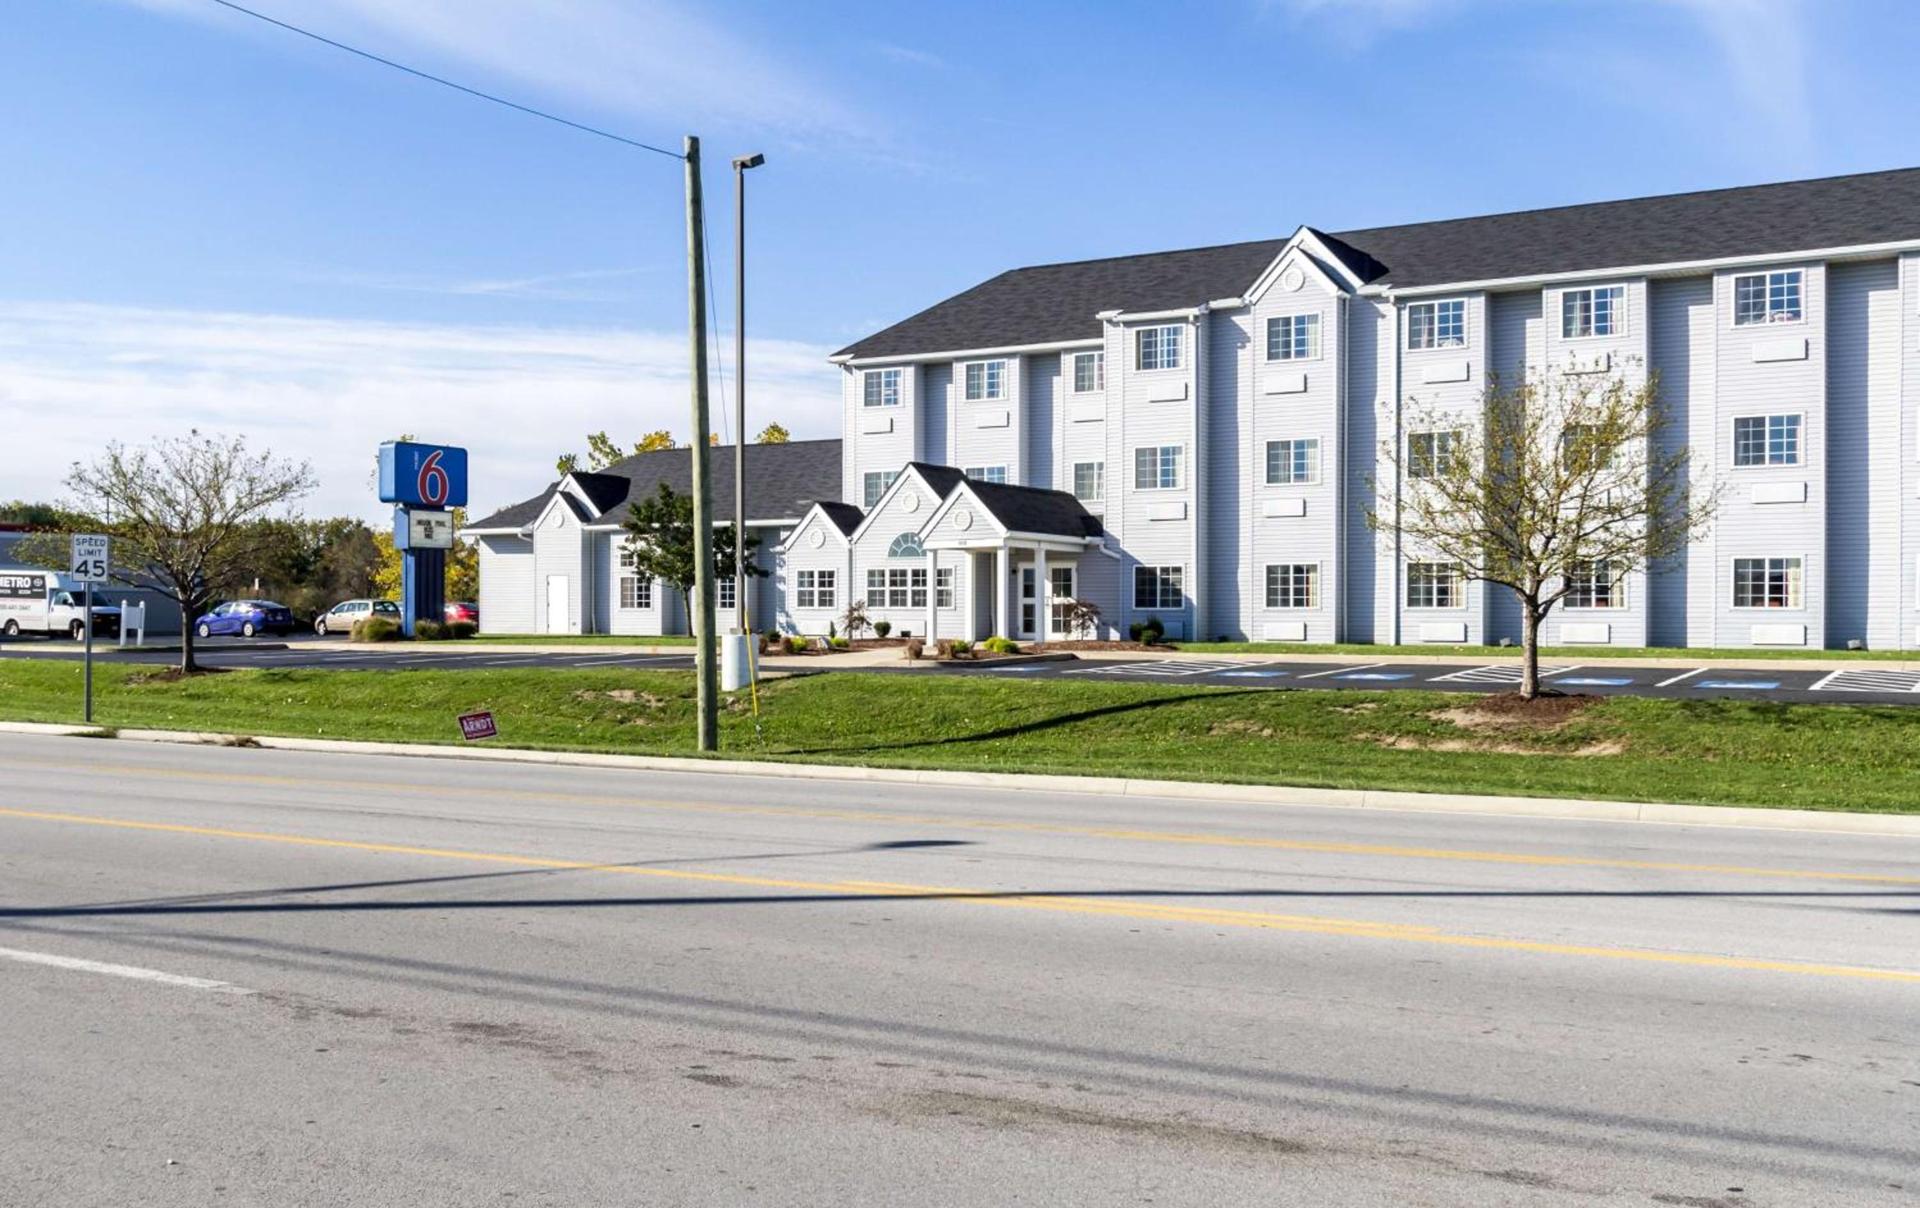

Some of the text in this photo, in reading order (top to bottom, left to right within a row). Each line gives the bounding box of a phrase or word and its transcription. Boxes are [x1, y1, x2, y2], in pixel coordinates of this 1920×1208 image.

[418, 450, 449, 505] 6
[75, 537, 106, 547] SPEED
[78, 549, 103, 557] LIMIT
[75, 559, 106, 577] 45
